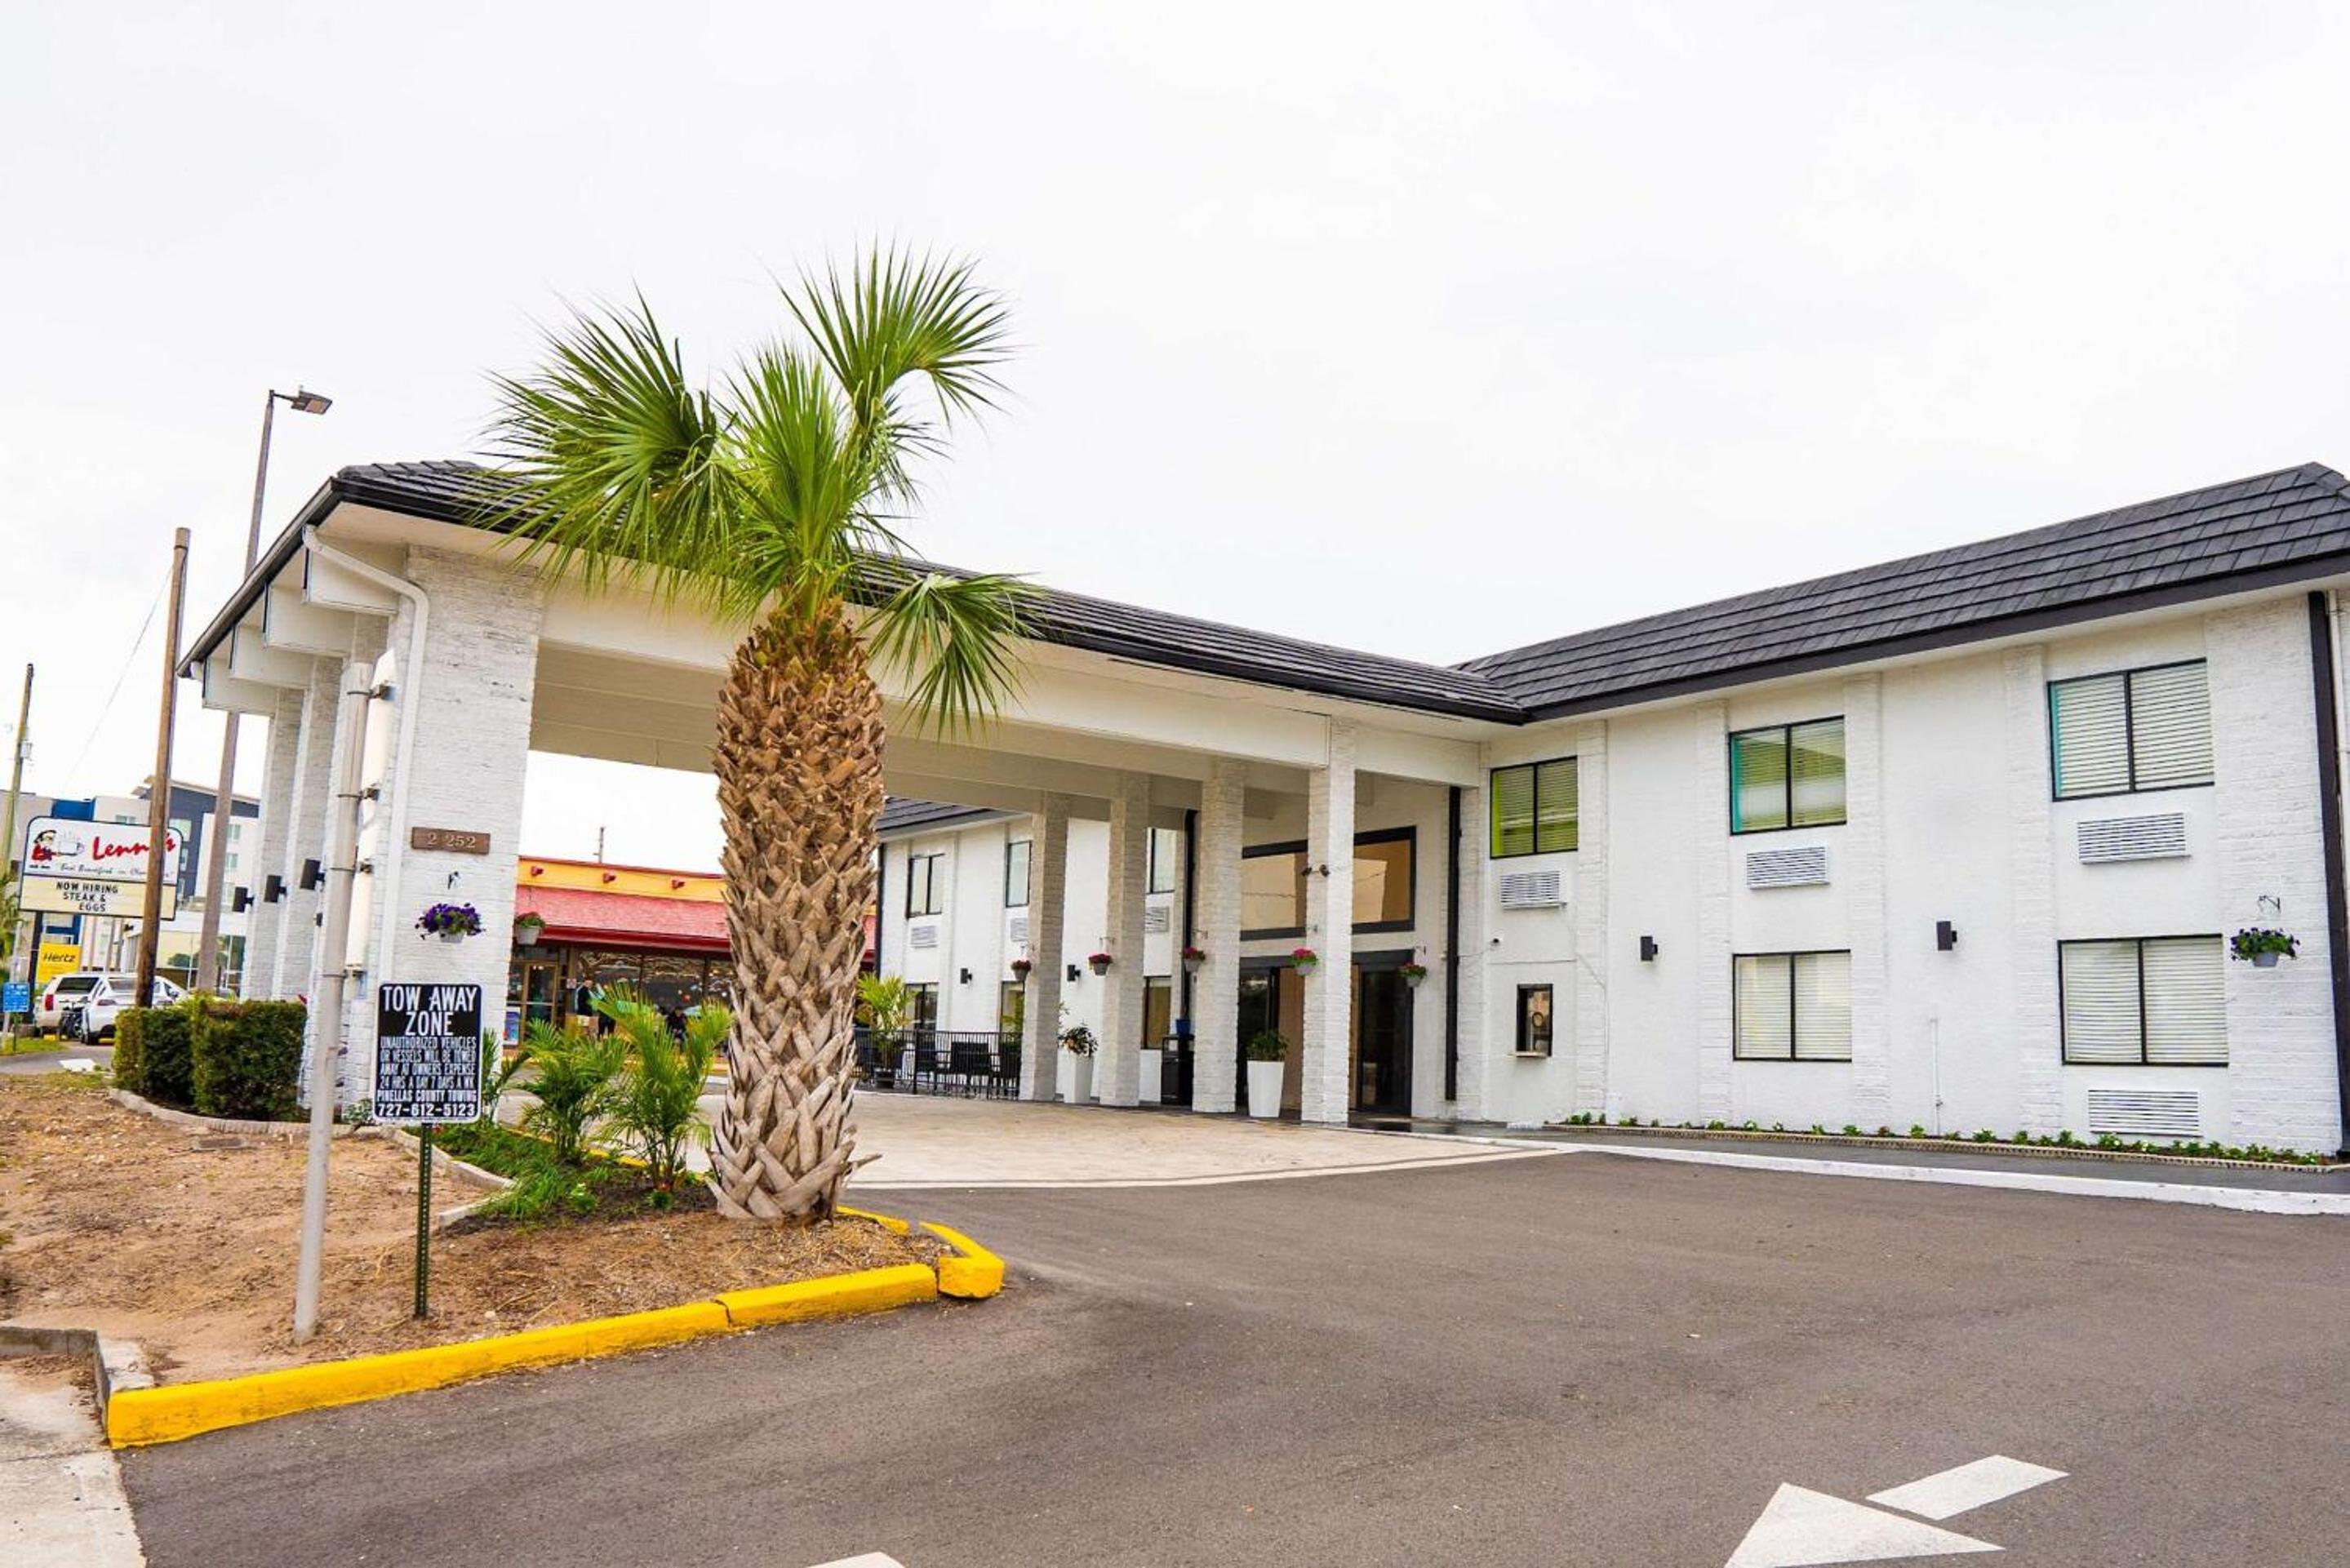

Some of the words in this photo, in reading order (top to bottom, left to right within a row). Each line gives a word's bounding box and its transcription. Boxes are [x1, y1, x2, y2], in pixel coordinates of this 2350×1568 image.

[92, 833, 175, 860] Lenn's
[56, 882, 79, 891] NOW
[82, 882, 118, 894] HIRING
[63, 892, 96, 903] STEAK
[100, 894, 106, 903] &
[78, 904, 106, 913] EGGS
[43, 953, 76, 962] Hertz
[383, 986, 421, 1011] TOW
[429, 986, 478, 1011] AWAY
[405, 1011, 454, 1037] ZONE
[380, 1037, 438, 1049] UNAUTHORIZED
[442, 1037, 476, 1049] VEHICLES
[380, 1050, 390, 1062] OR
[393, 1050, 421, 1062] VESSELS
[424, 1050, 439, 1063] WILL
[442, 1050, 451, 1063] BE
[454, 1050, 476, 1063] TOWED
[380, 1064, 398, 1075] AWAY
[401, 1064, 409, 1076] AT
[412, 1064, 441, 1075] OWNERS
[445, 1064, 475, 1075] EXPENSE
[380, 1077, 389, 1089] 24
[392, 1077, 406, 1089] HRS
[408, 1077, 414, 1089] A
[416, 1077, 429, 1089] DAY
[431, 1077, 435, 1089] 7
[438, 1077, 453, 1089] DAYS
[456, 1077, 462, 1089] A
[464, 1077, 474, 1089] WK
[377, 1090, 412, 1101] PINELLAS
[415, 1090, 445, 1101] COUNTY
[448, 1090, 477, 1101] TOWING
[378, 1104, 475, 1117] 727-612-5123
